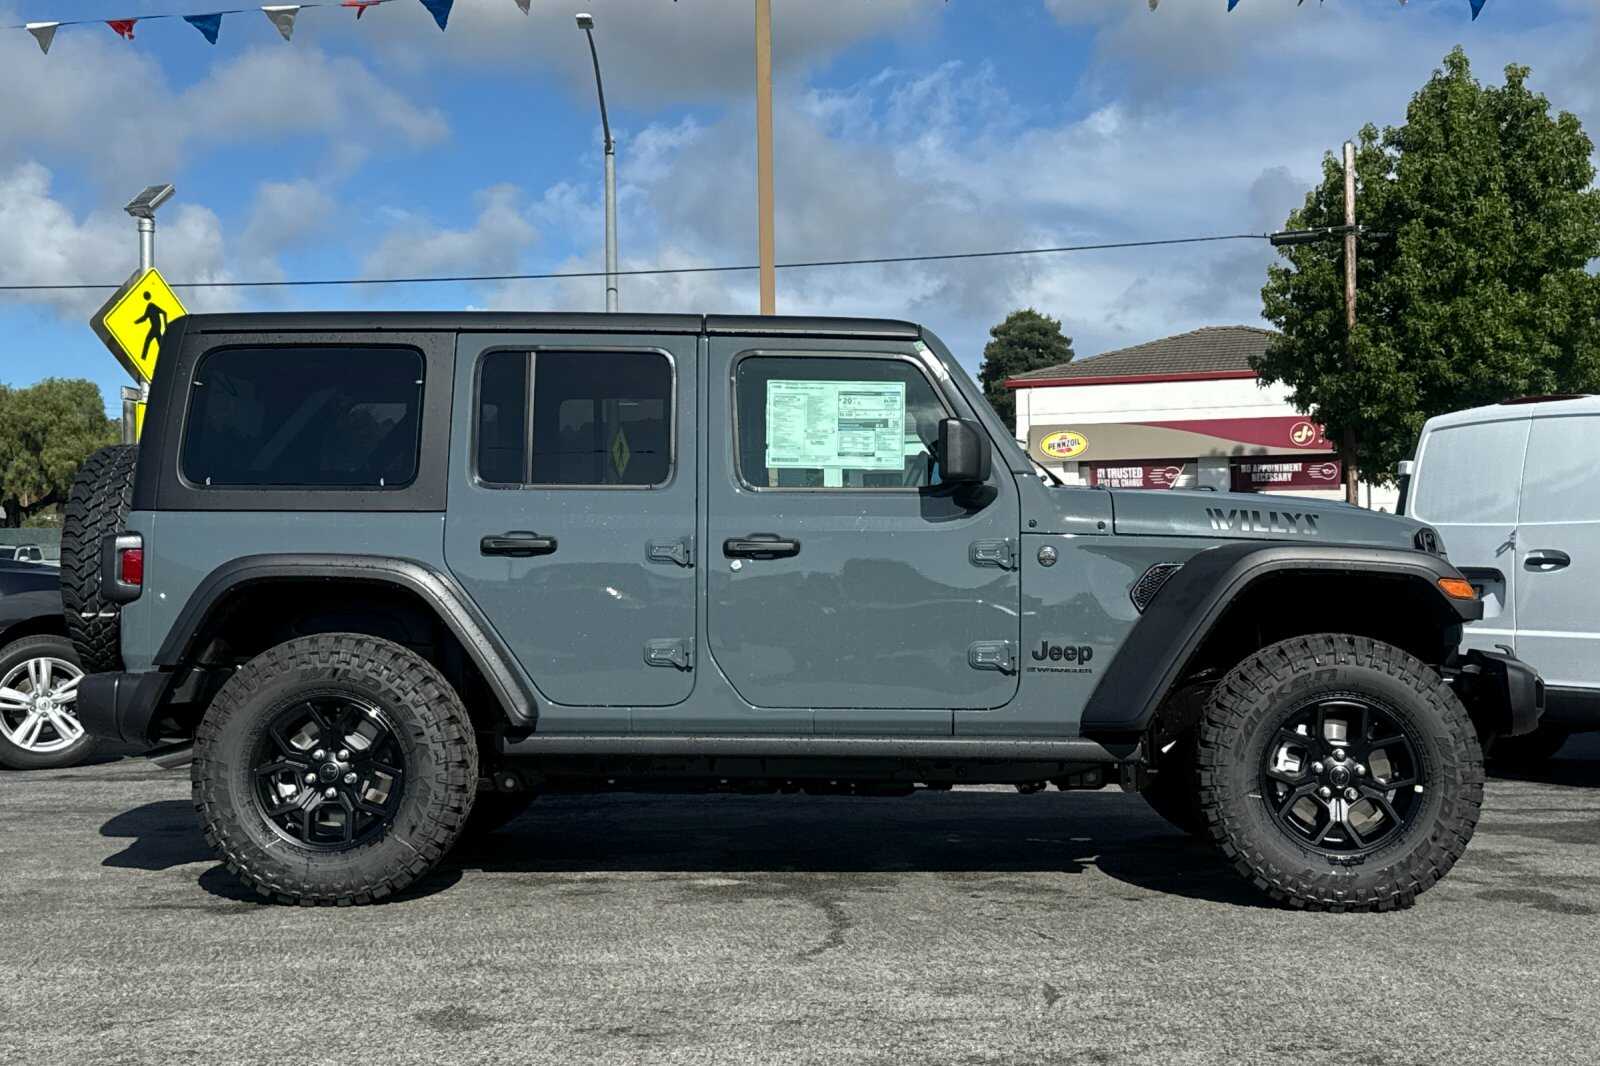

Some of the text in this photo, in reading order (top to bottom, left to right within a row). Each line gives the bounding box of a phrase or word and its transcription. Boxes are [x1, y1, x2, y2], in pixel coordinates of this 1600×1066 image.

[1048, 438, 1081, 450] PENNZOIL
[1106, 467, 1143, 479] TRUSTED
[1252, 462, 1303, 473] APPOINTMENT
[1251, 472, 1293, 482] NECESSARY
[1205, 507, 1319, 535] WILLYS
[1031, 640, 1093, 666] Jeep
